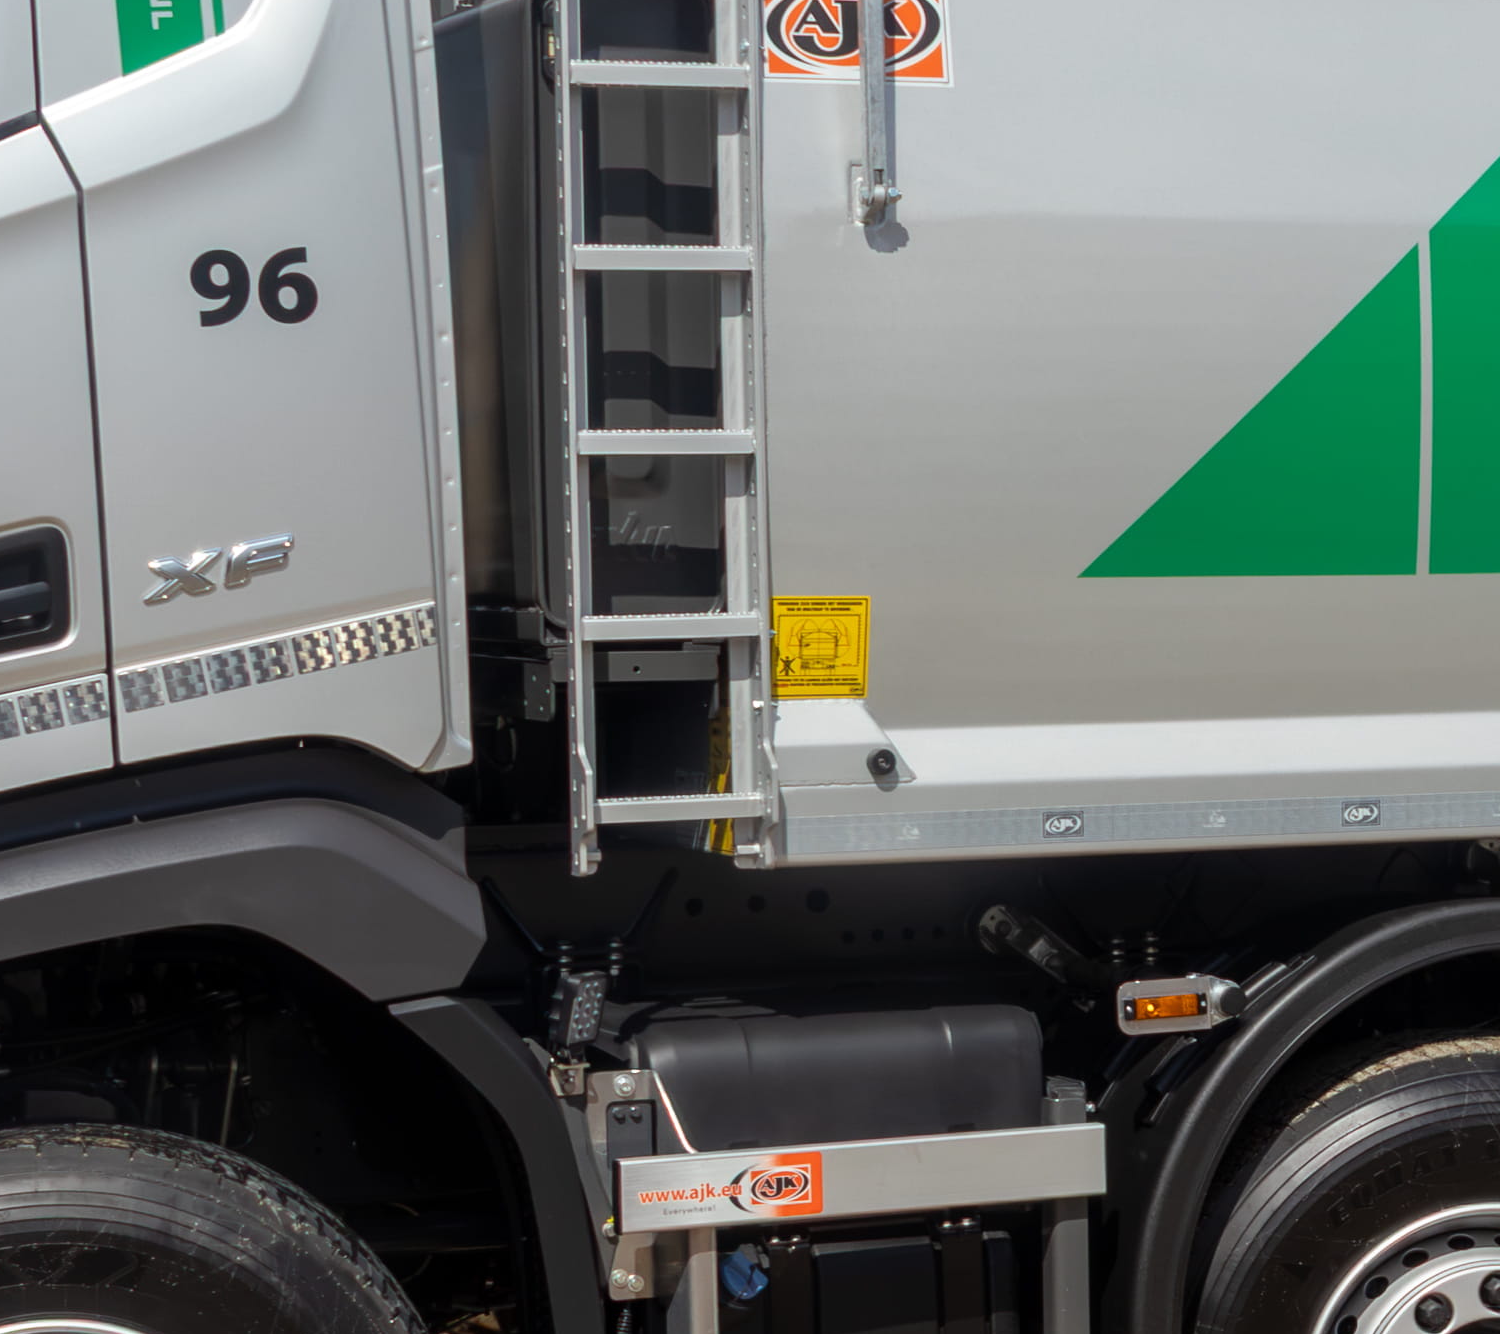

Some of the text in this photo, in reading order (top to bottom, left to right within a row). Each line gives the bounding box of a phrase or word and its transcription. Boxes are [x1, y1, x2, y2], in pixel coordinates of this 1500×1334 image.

[190, 247, 318, 327] 96
[143, 532, 294, 606] XF
[638, 1184, 743, 1204] www.ajk.eu
[758, 1175, 798, 1198] AJK
